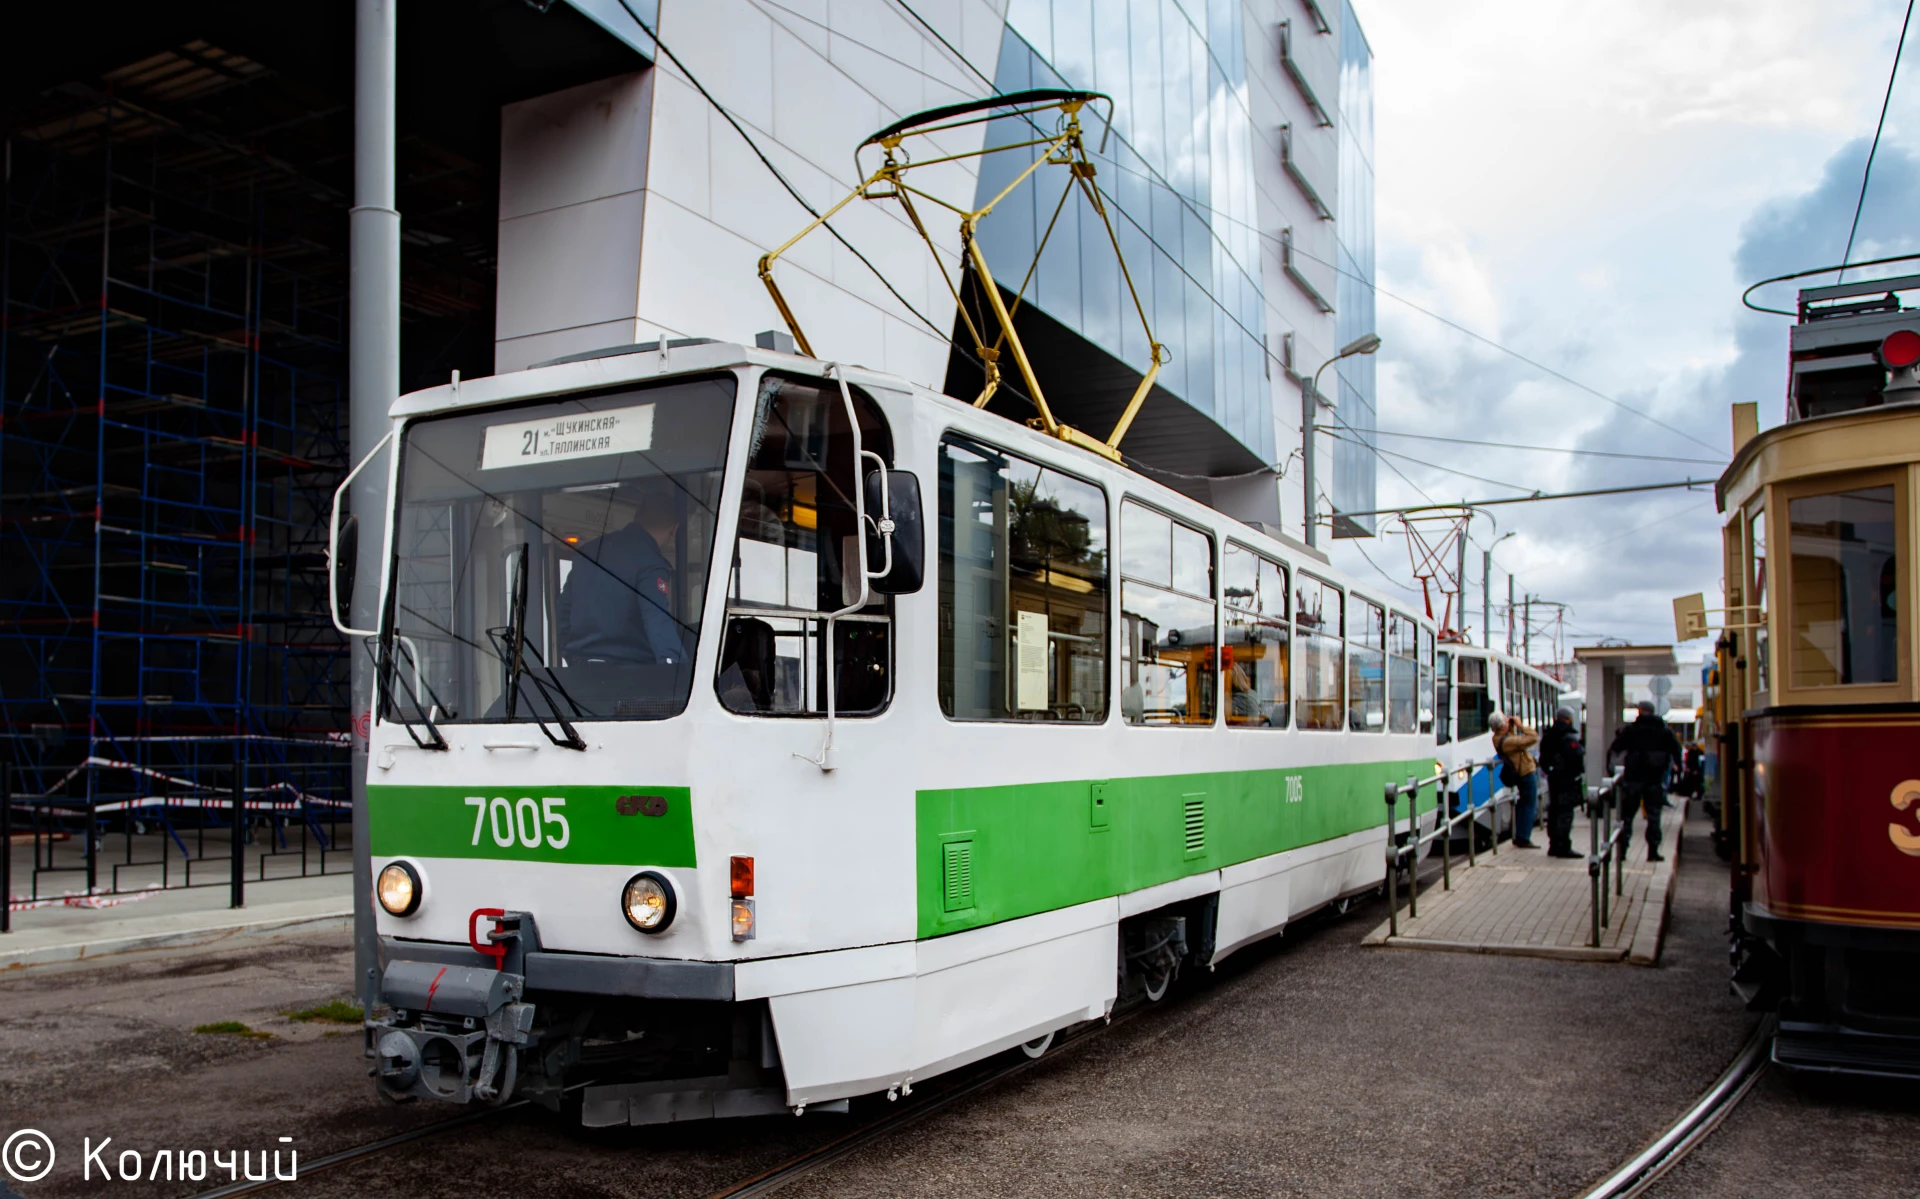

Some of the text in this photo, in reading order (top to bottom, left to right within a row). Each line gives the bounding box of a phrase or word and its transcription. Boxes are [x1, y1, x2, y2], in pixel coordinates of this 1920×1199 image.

[521, 429, 539, 456] 21
[1285, 775, 1303, 804] 7005
[464, 797, 570, 849] 7005
